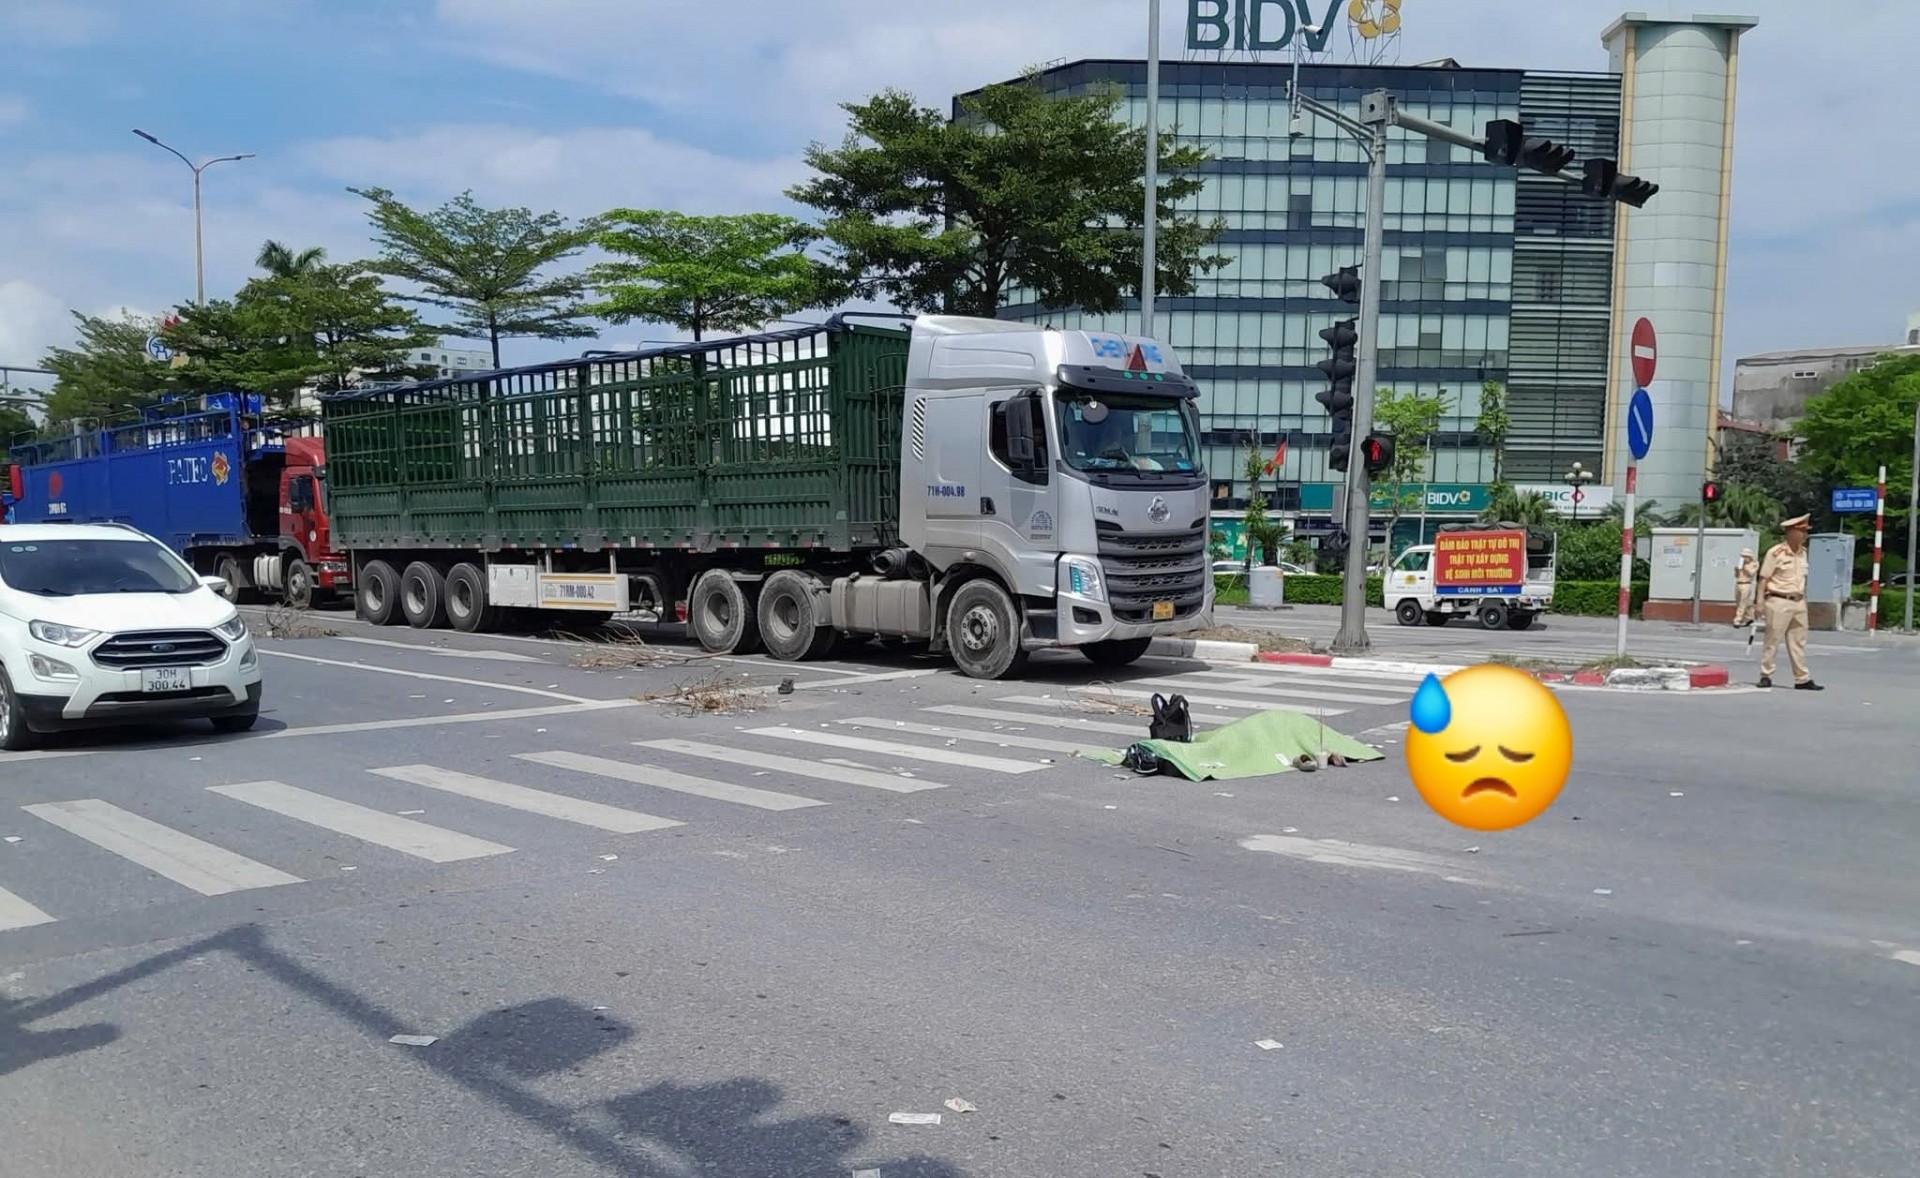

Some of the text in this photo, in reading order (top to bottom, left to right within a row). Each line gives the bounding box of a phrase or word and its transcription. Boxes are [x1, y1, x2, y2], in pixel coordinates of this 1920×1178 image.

[1188, 0, 1344, 51] BIDV
[1428, 492, 1459, 505] BIDV
[156, 669, 177, 679] 30H
[148, 680, 186, 691] 300.44
